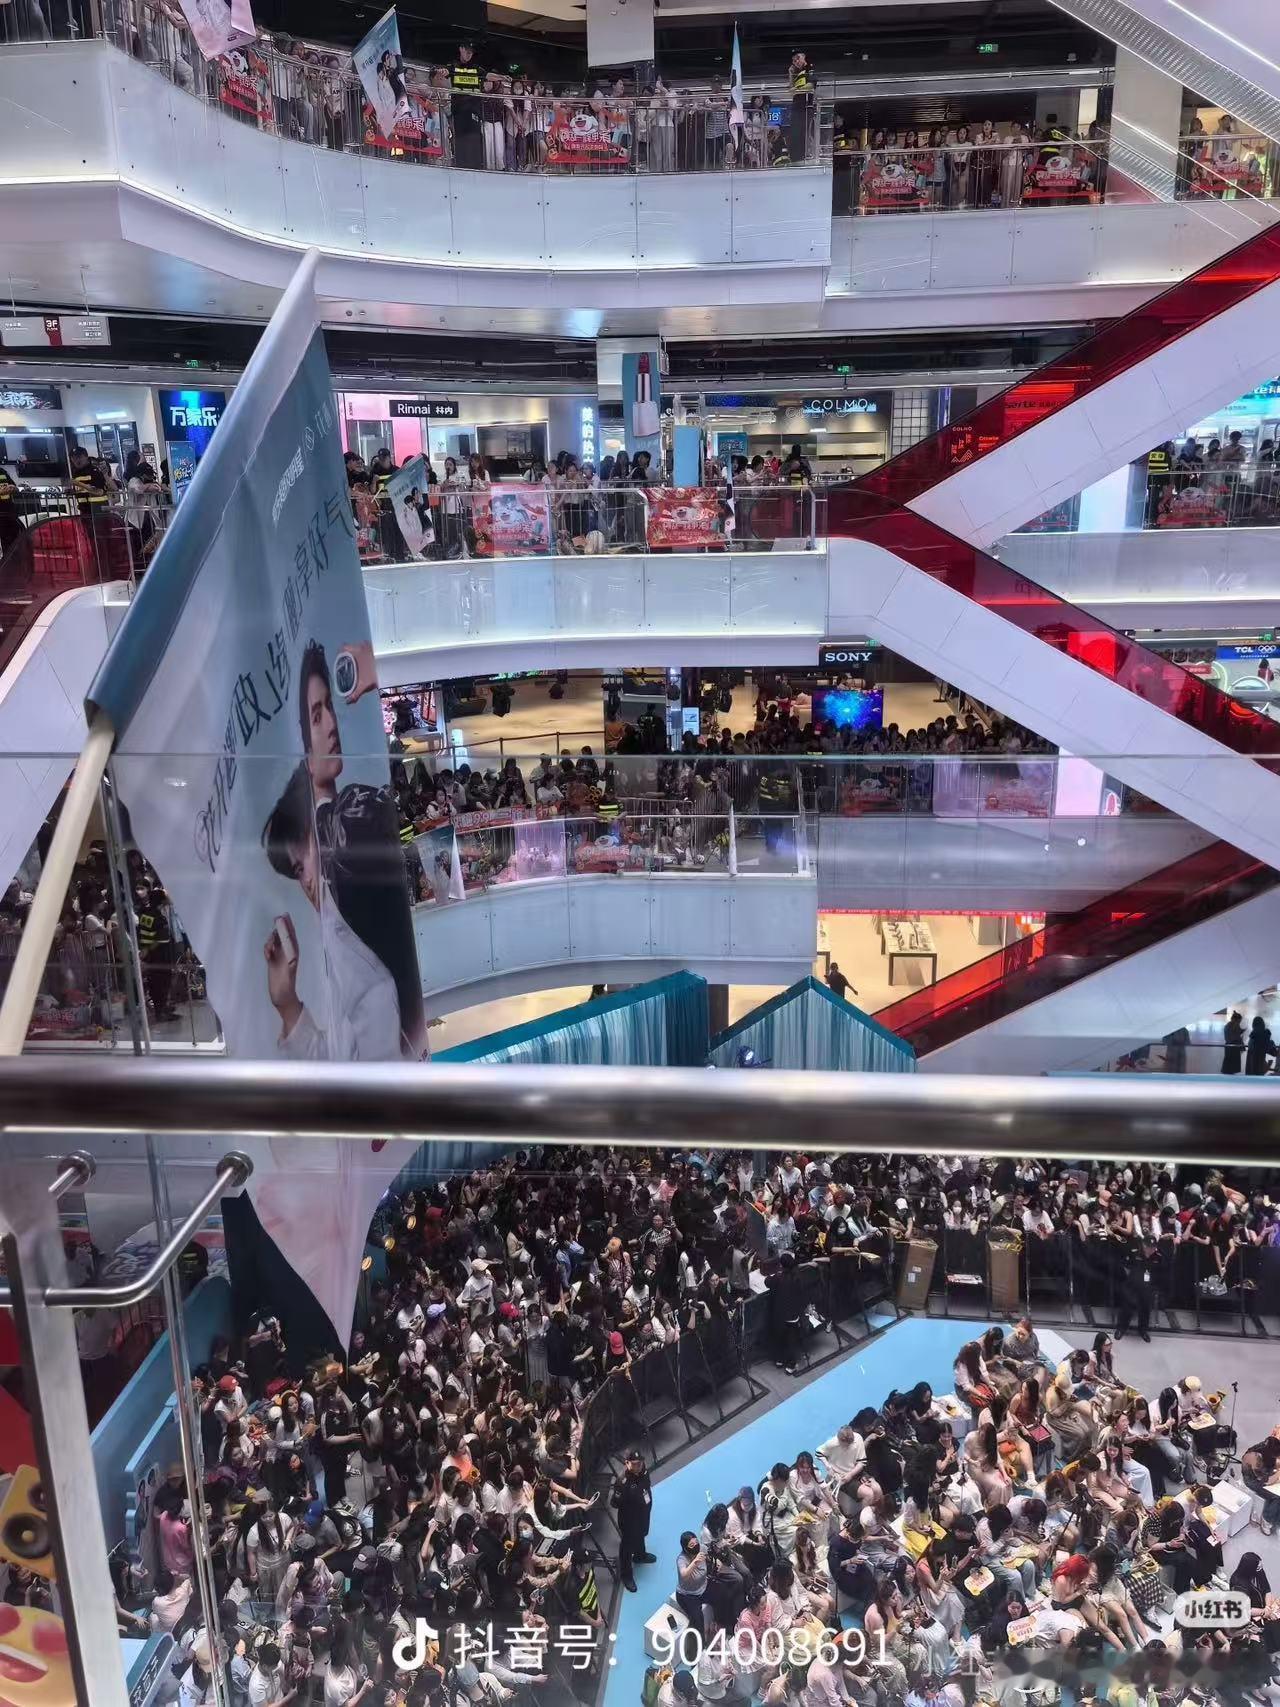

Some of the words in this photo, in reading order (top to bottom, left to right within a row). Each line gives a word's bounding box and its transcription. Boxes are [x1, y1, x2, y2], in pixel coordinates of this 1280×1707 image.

[45, 319, 58, 328] 3F
[397, 403, 431, 415] Rinnai
[435, 405, 453, 415] 林内
[811, 398, 869, 411] COLMO
[170, 407, 218, 427] 万家乐
[825, 652, 873, 662] SONY
